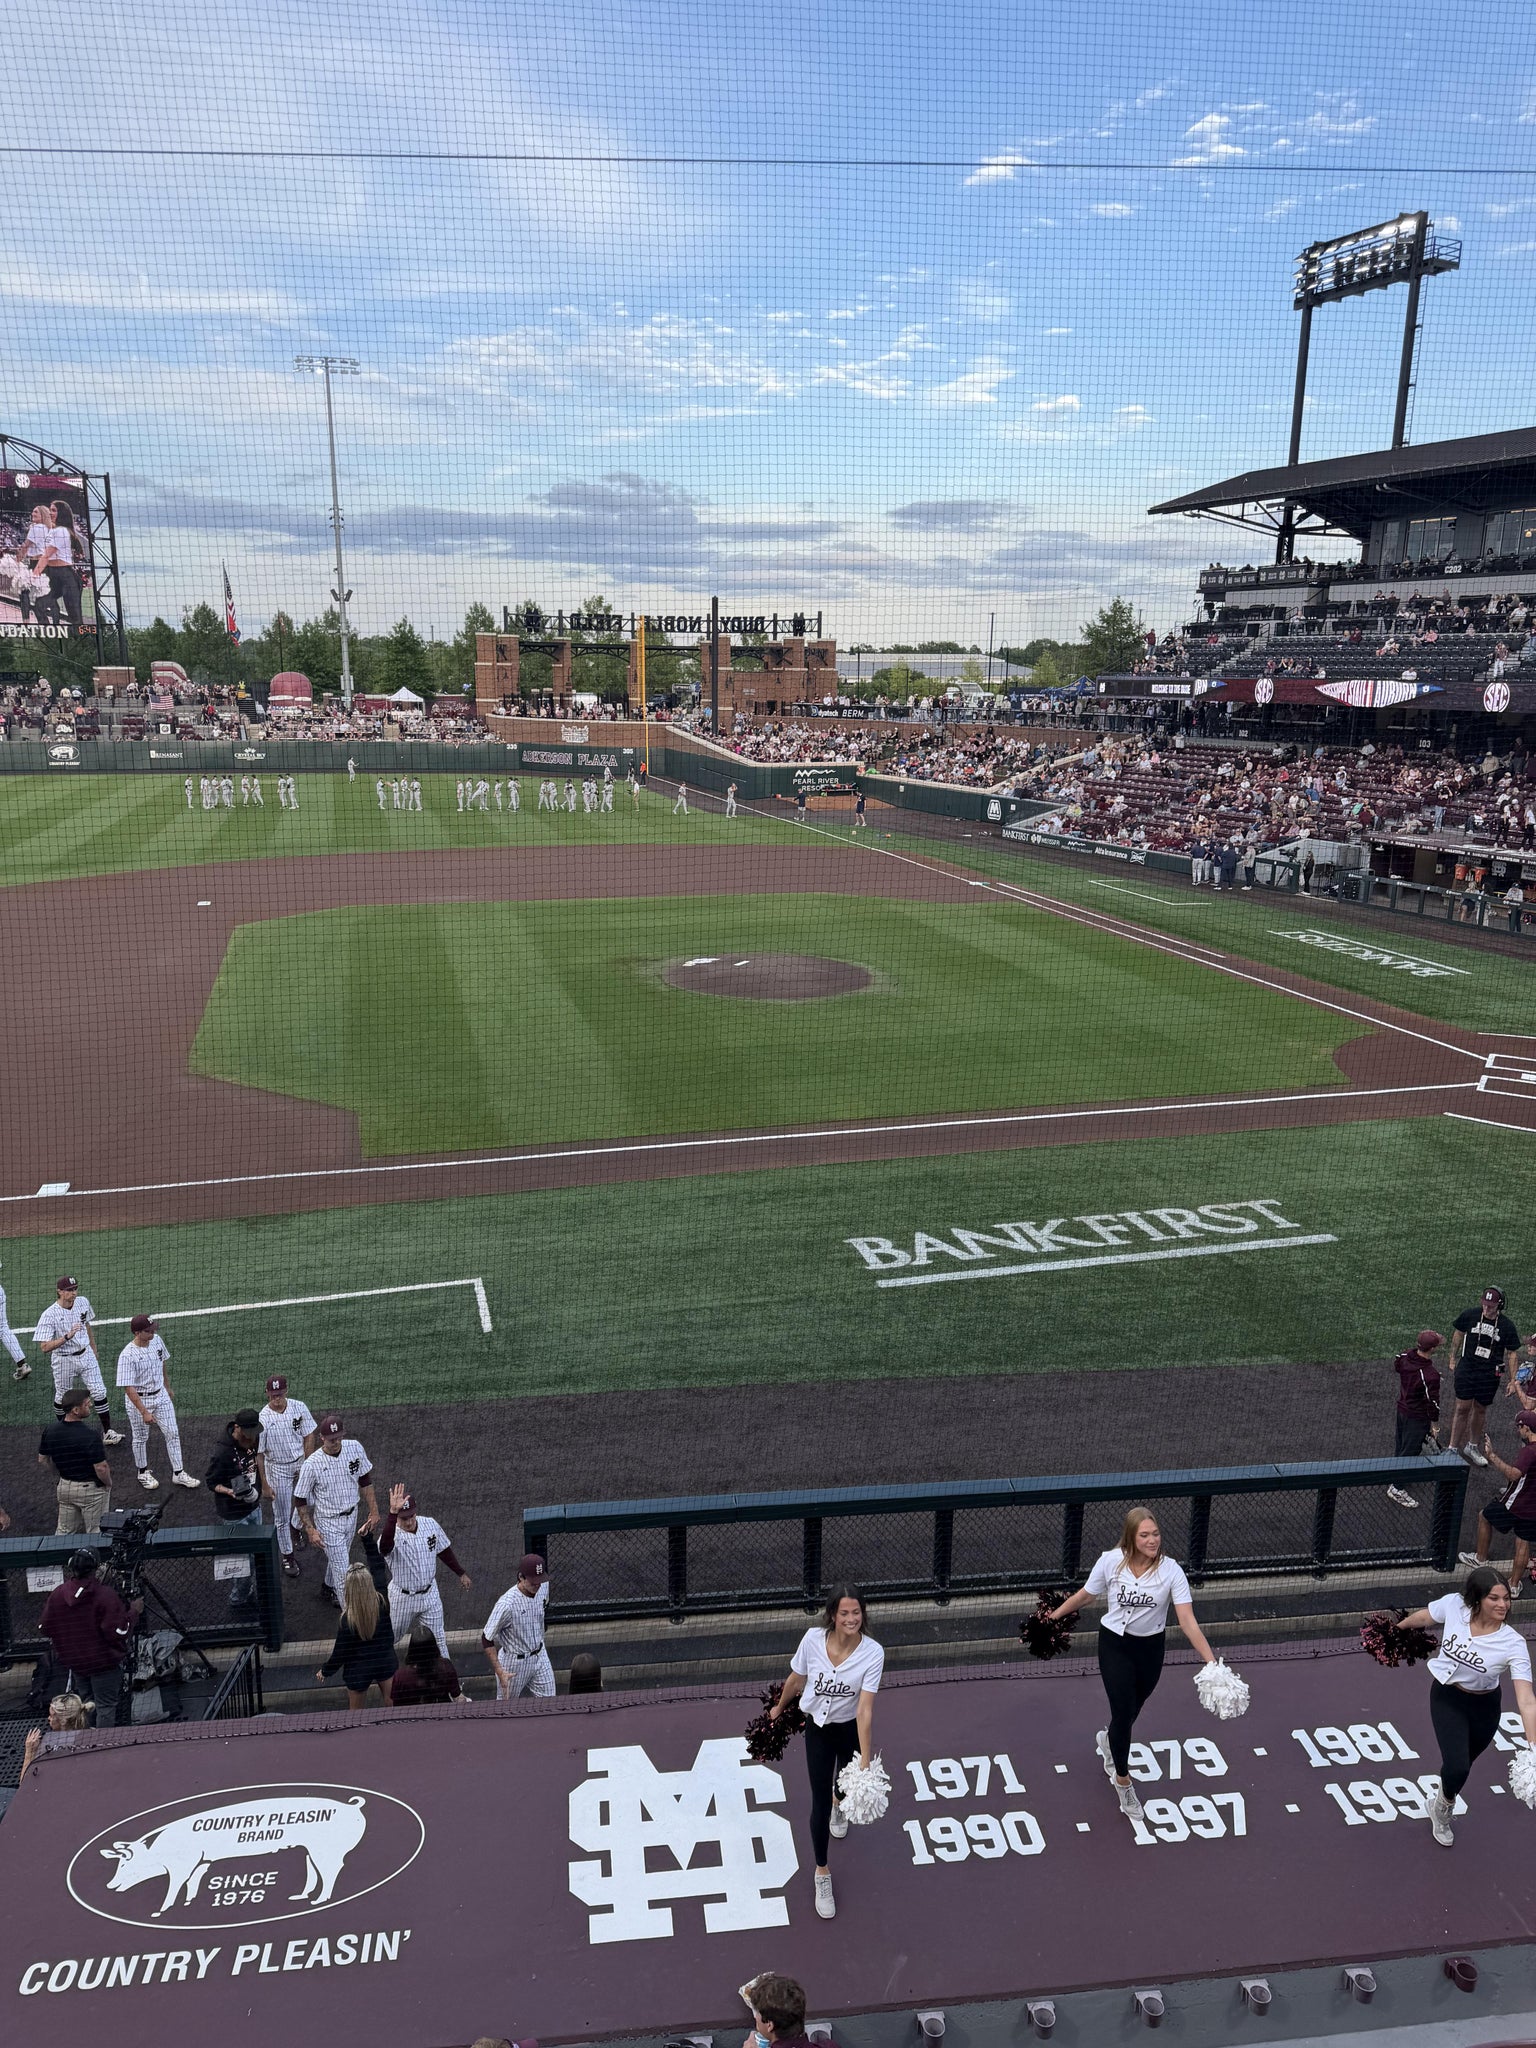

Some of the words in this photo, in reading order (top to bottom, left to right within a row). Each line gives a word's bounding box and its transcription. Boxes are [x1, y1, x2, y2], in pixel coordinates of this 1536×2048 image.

[1445, 565, 1462, 573] C202
[1256, 679, 1273, 703] SEC
[1373, 680, 1417, 707] AUBURN
[1486, 682, 1508, 712] SEC
[842, 709, 864, 717] BERM
[1419, 739, 1431, 748] 103
[577, 754, 618, 766] PLAZA
[843, 1200, 1300, 1270] BANKFIRST
[1117, 1585, 1157, 1608] State
[1442, 1634, 1487, 1674] State
[813, 1672, 856, 1697] State
[905, 1753, 1027, 1802] 1971
[1291, 1721, 1420, 1768] 1981
[192, 1813, 266, 1834] COUNTRY
[267, 1808, 338, 1826] PLEASIN'
[902, 1810, 1046, 1865] 1990
[1120, 1792, 1247, 1846] 1997
[237, 1828, 284, 1844] BRAND
[208, 1870, 279, 1891] SINCE
[211, 1889, 266, 1907] 1976
[19, 1947, 220, 1996] COUNTRY
[231, 1929, 413, 1977] PLEASIN'
